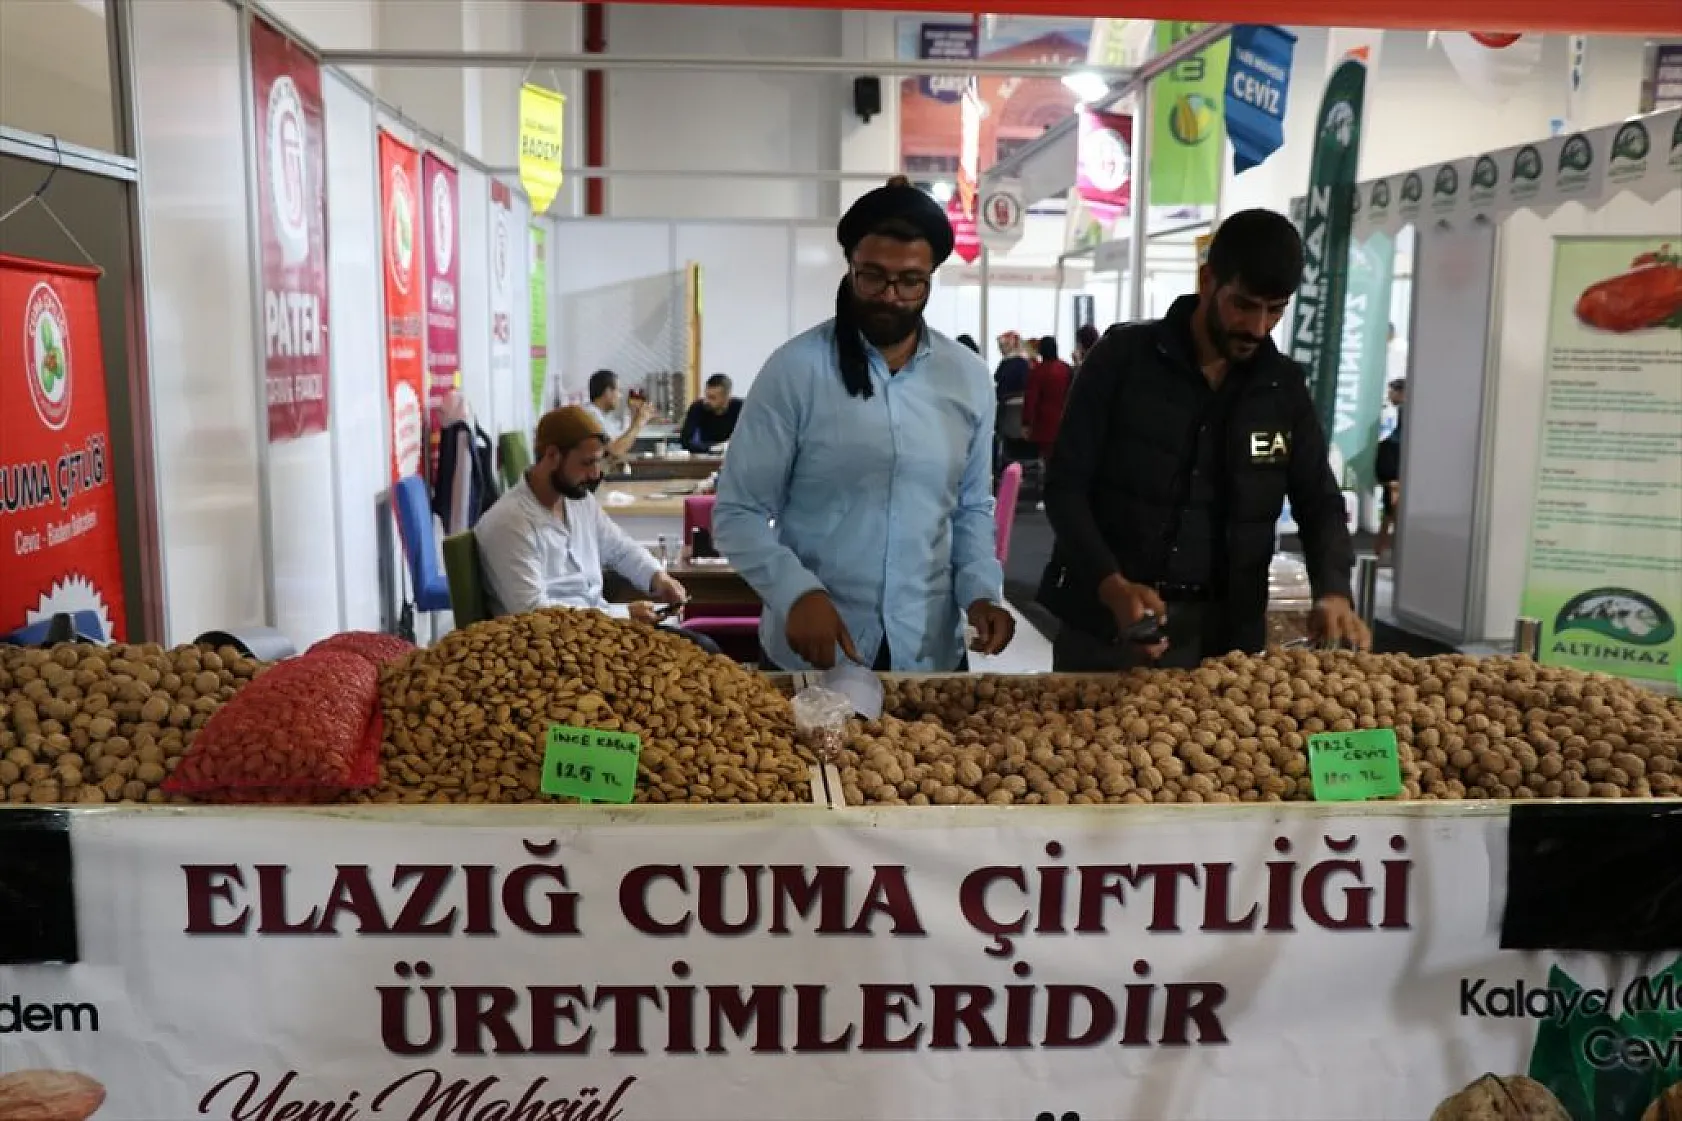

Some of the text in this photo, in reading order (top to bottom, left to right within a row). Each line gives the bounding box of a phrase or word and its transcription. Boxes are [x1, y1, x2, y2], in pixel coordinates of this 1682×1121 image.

[1233, 72, 1281, 115] CEVİZ
[1294, 184, 1332, 386] INKAZ
[1250, 431, 1292, 457] EA
[1552, 641, 1670, 666] ALTINKAZ
[601, 772, 624, 787] TL
[182, 834, 1412, 957] ELAZIĞ CUMA ÇİFTLİĞİ
[376, 961, 1229, 1055] ÜRETİMLERİDİR
[198, 1070, 361, 1121] Yeni
